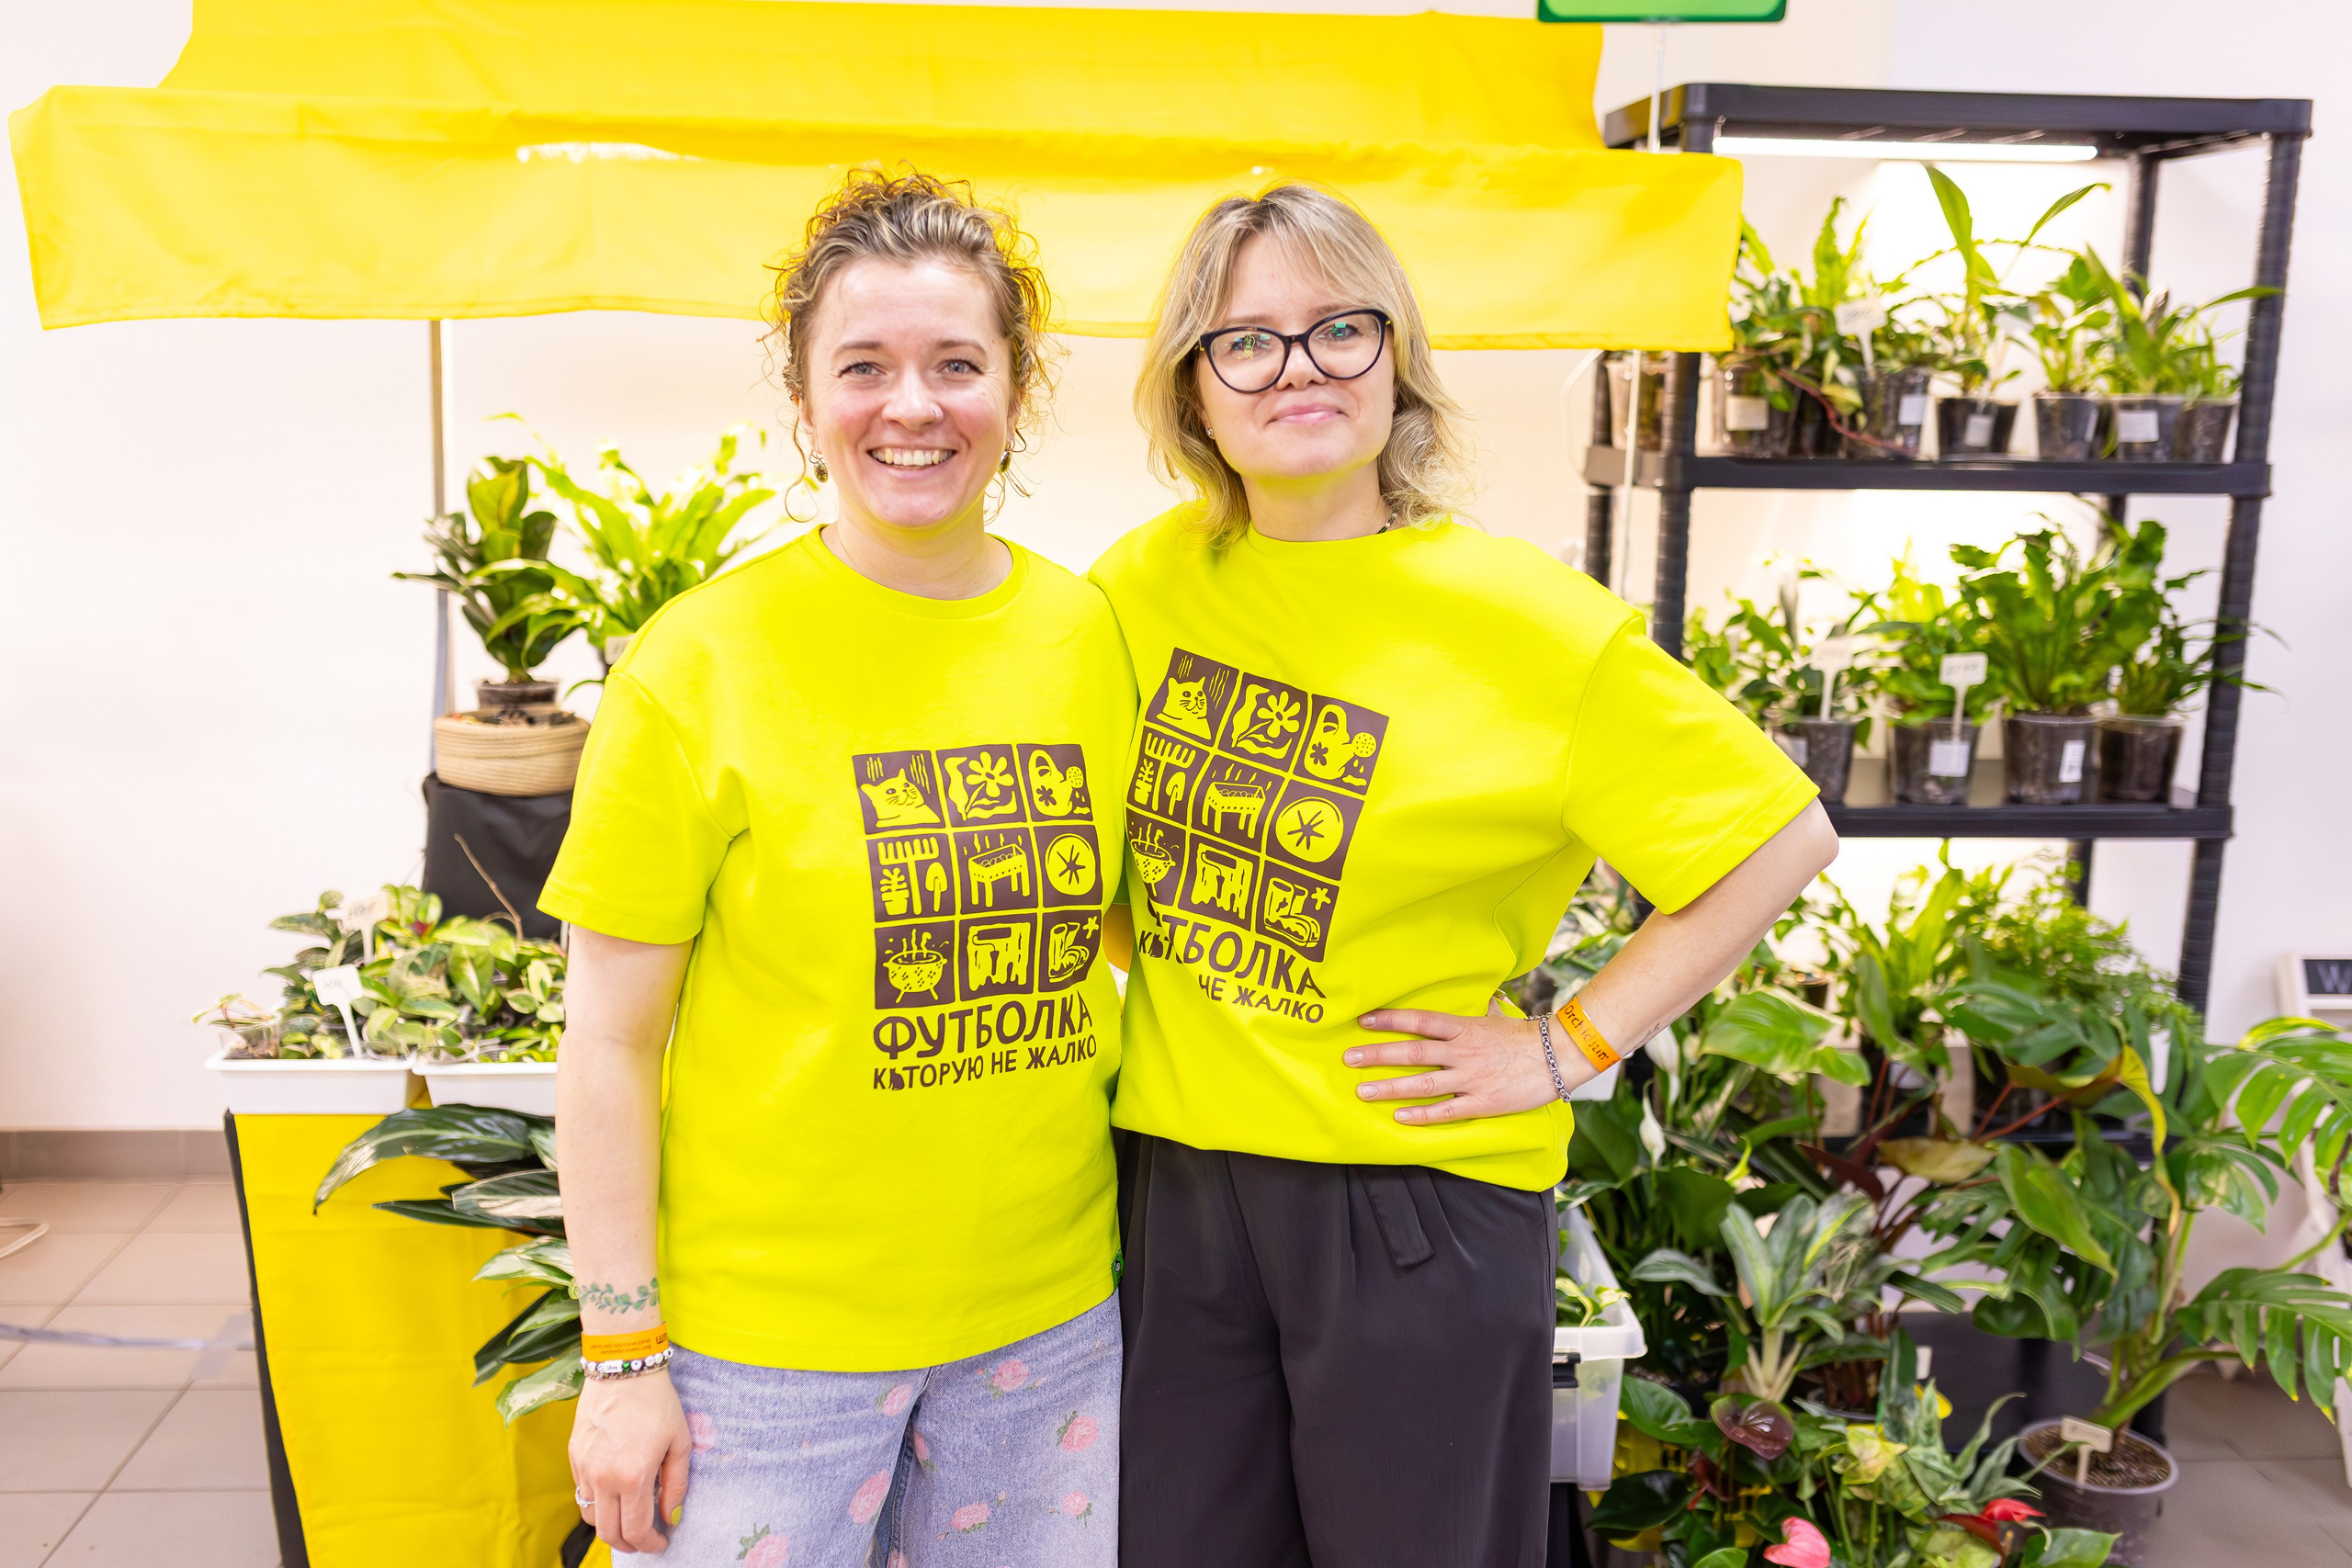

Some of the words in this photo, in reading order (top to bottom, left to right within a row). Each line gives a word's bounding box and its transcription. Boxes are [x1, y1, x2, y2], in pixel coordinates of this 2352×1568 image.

[1157, 911, 1326, 998] ТБОЛКА
[874, 989, 1092, 1059] ФУТБОЛКА
[1199, 975, 1227, 1001] НЕ
[1232, 985, 1324, 1023] ЖАЛКО
[874, 1055, 984, 1091] КТОРУЮ
[991, 1050, 1018, 1075] НЕ
[1025, 1034, 1097, 1070] ЖАЛКО
